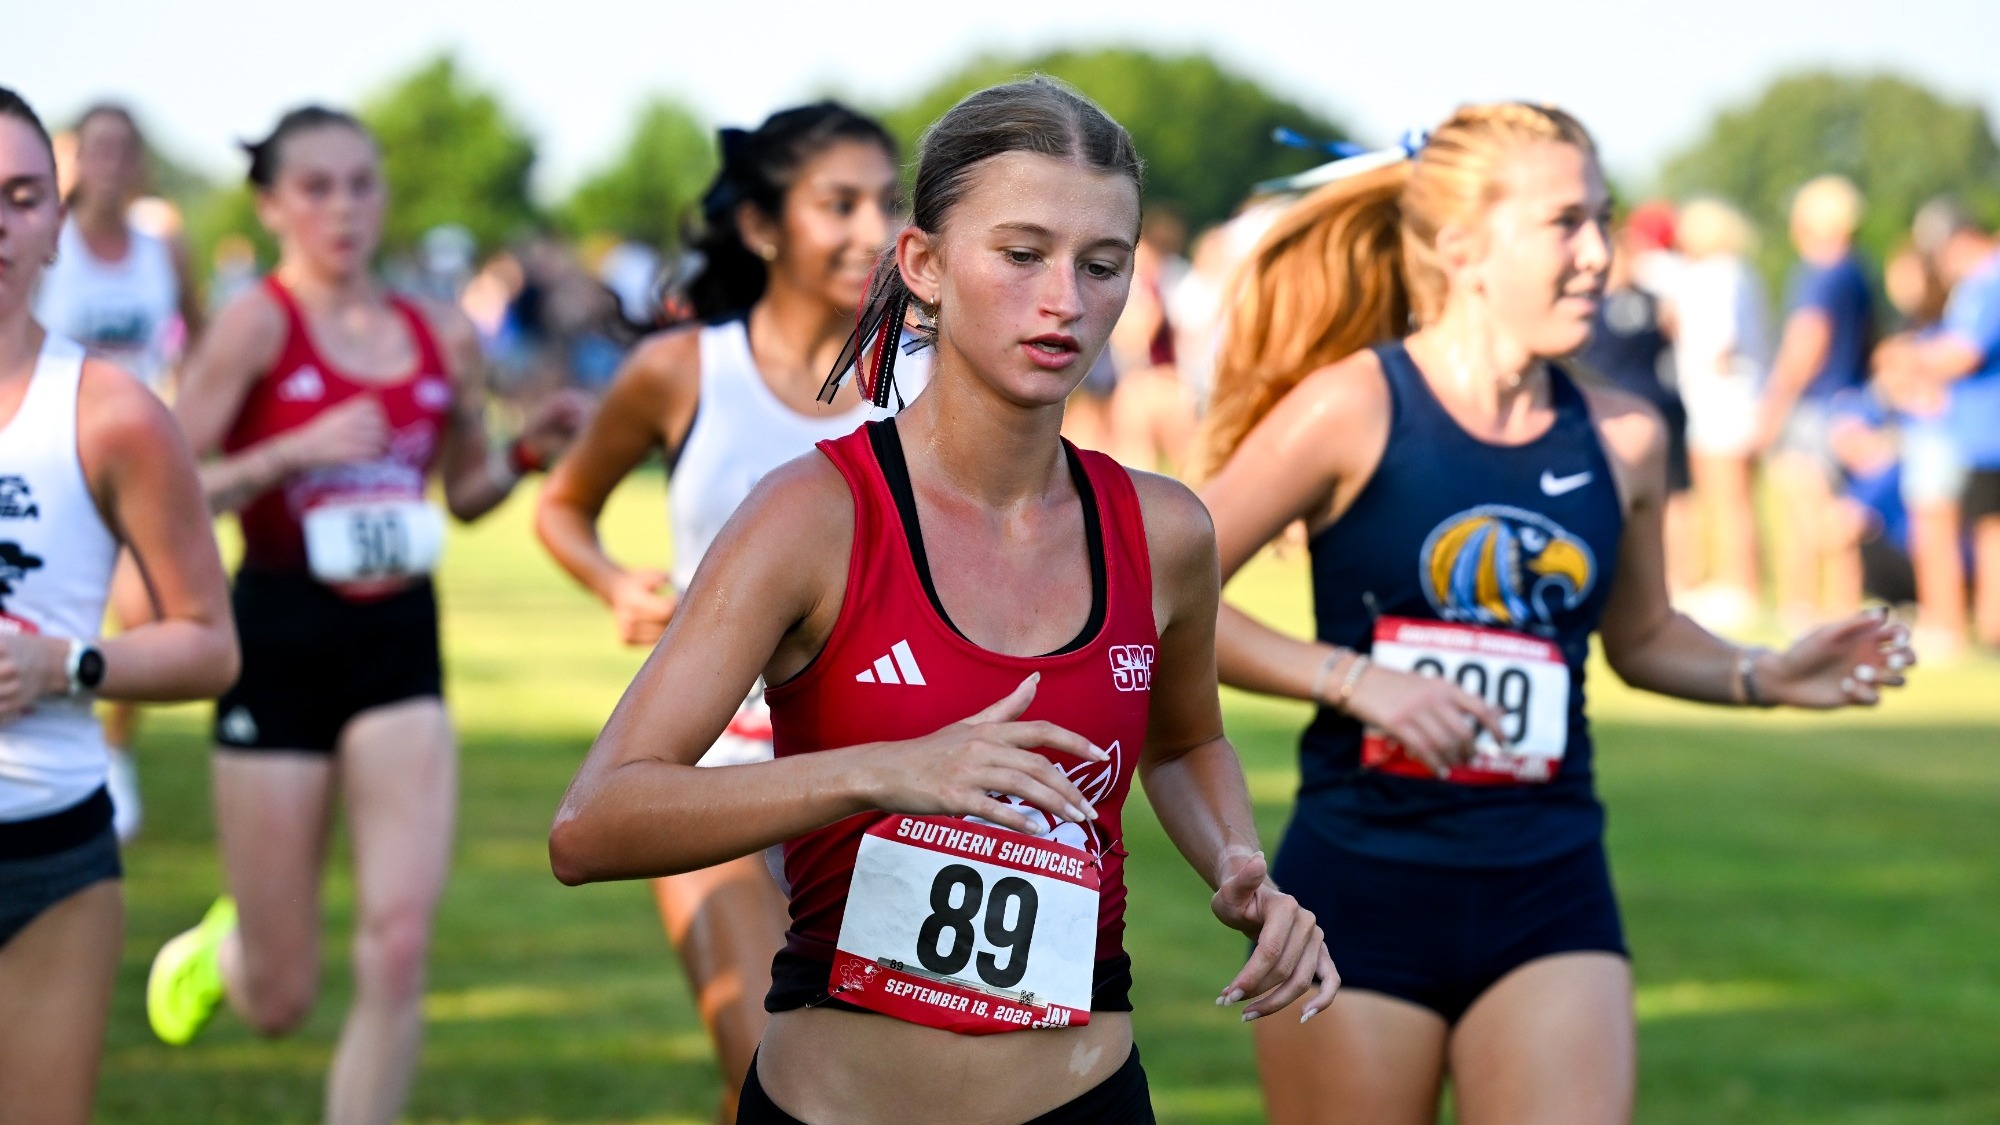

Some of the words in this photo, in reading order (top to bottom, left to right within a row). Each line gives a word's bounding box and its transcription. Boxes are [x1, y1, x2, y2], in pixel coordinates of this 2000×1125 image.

[897, 817, 997, 857] SOUTHERN
[998, 841, 1085, 880] SHOWCASE
[916, 863, 1039, 988] 89
[889, 959, 904, 971] 89
[884, 978, 969, 1012] SEPTEMBER
[971, 999, 989, 1019] 18,
[994, 1005, 1033, 1026] 2026
